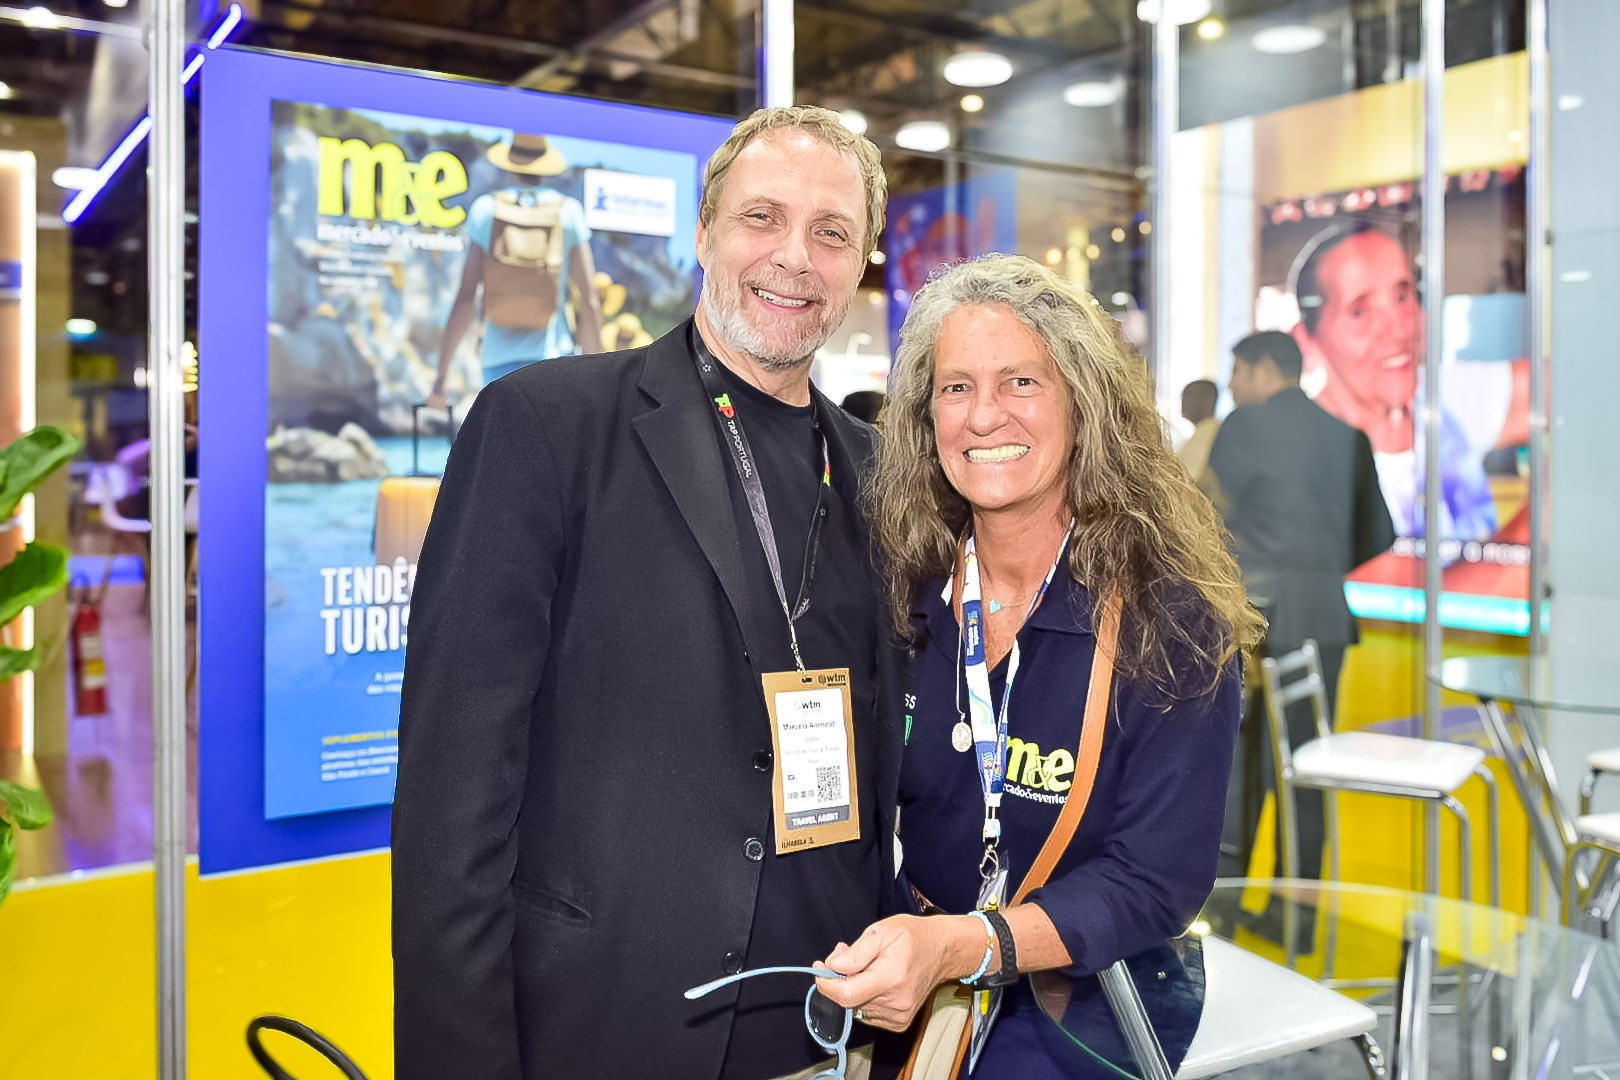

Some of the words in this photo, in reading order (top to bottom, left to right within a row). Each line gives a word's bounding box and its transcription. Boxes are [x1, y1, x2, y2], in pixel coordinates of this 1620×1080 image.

[317, 136, 469, 228] m&e
[734, 434, 752, 479] PORTUGAL
[320, 556, 417, 606] TENDÊ
[801, 700, 821, 709] wtm
[1006, 736, 1075, 793] m&e
